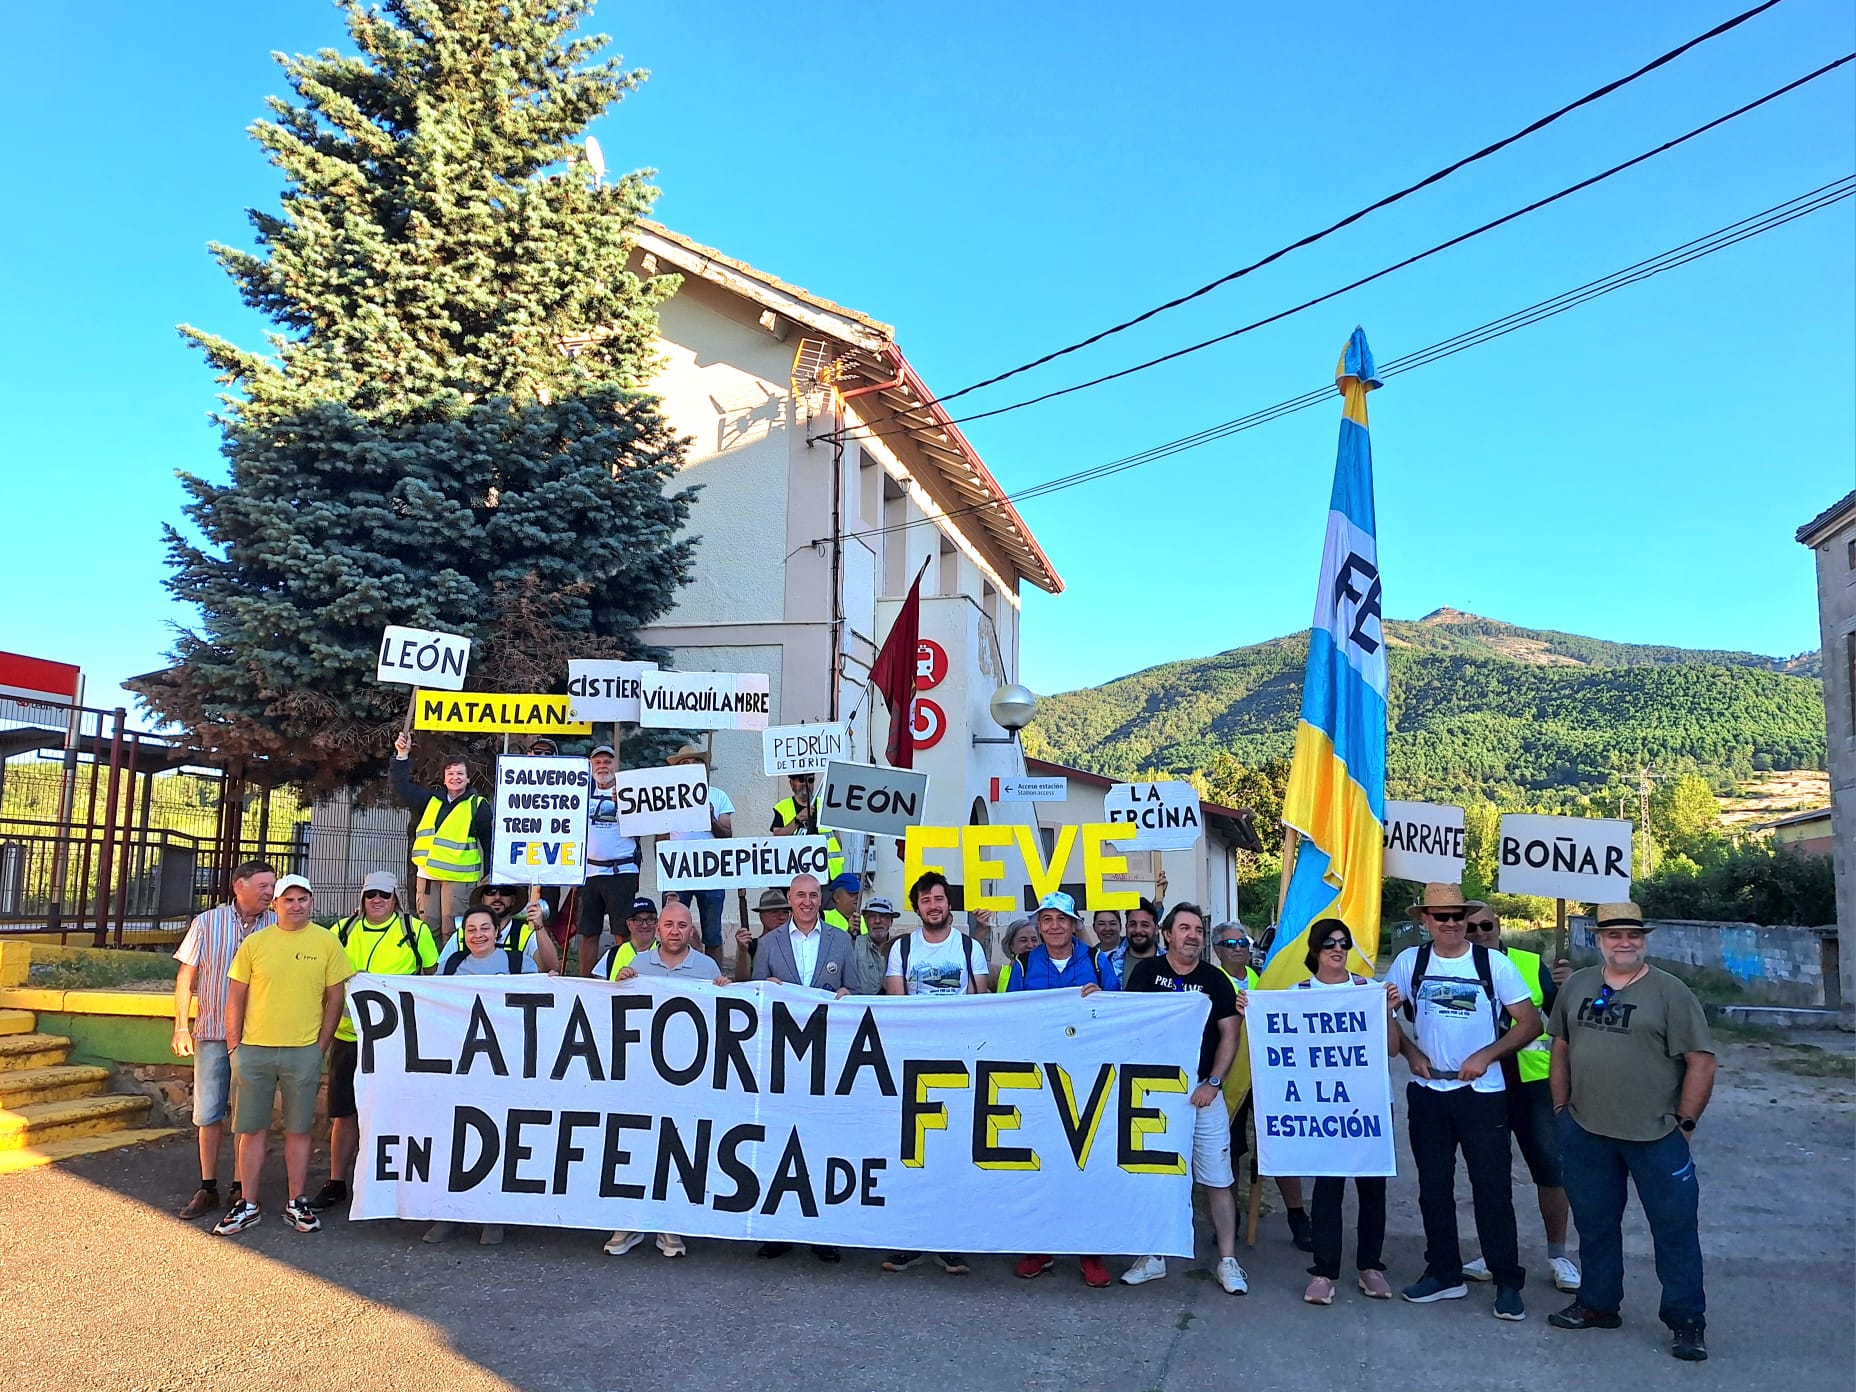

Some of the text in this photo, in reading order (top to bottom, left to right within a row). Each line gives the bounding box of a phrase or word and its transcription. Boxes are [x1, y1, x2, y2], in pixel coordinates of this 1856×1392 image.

[381, 637, 465, 677] LEÓN
[424, 700, 585, 725] MATALLAN
[774, 729, 841, 758] PEDRÚN
[777, 761, 787, 769] DE
[508, 793, 580, 810] NUESTRO
[617, 782, 708, 815] SABERO
[826, 783, 917, 817] LEÓN
[1131, 783, 1161, 802] LA
[503, 817, 571, 834] TREN DE
[659, 841, 828, 879] VALDEPIÉLAGO
[904, 821, 1141, 912] FEVE
[1502, 836, 1630, 878] BOÑAR
[1266, 1011, 1368, 1034] EL TREN
[351, 989, 898, 1097] PLATAFORMA
[1266, 1045, 1369, 1068] DE FEVE
[1285, 1080, 1351, 1103] A LA
[1265, 1108, 1382, 1138] ESTACIÓN
[376, 1060, 1189, 1217] EN DEFENSA DE FEVE
